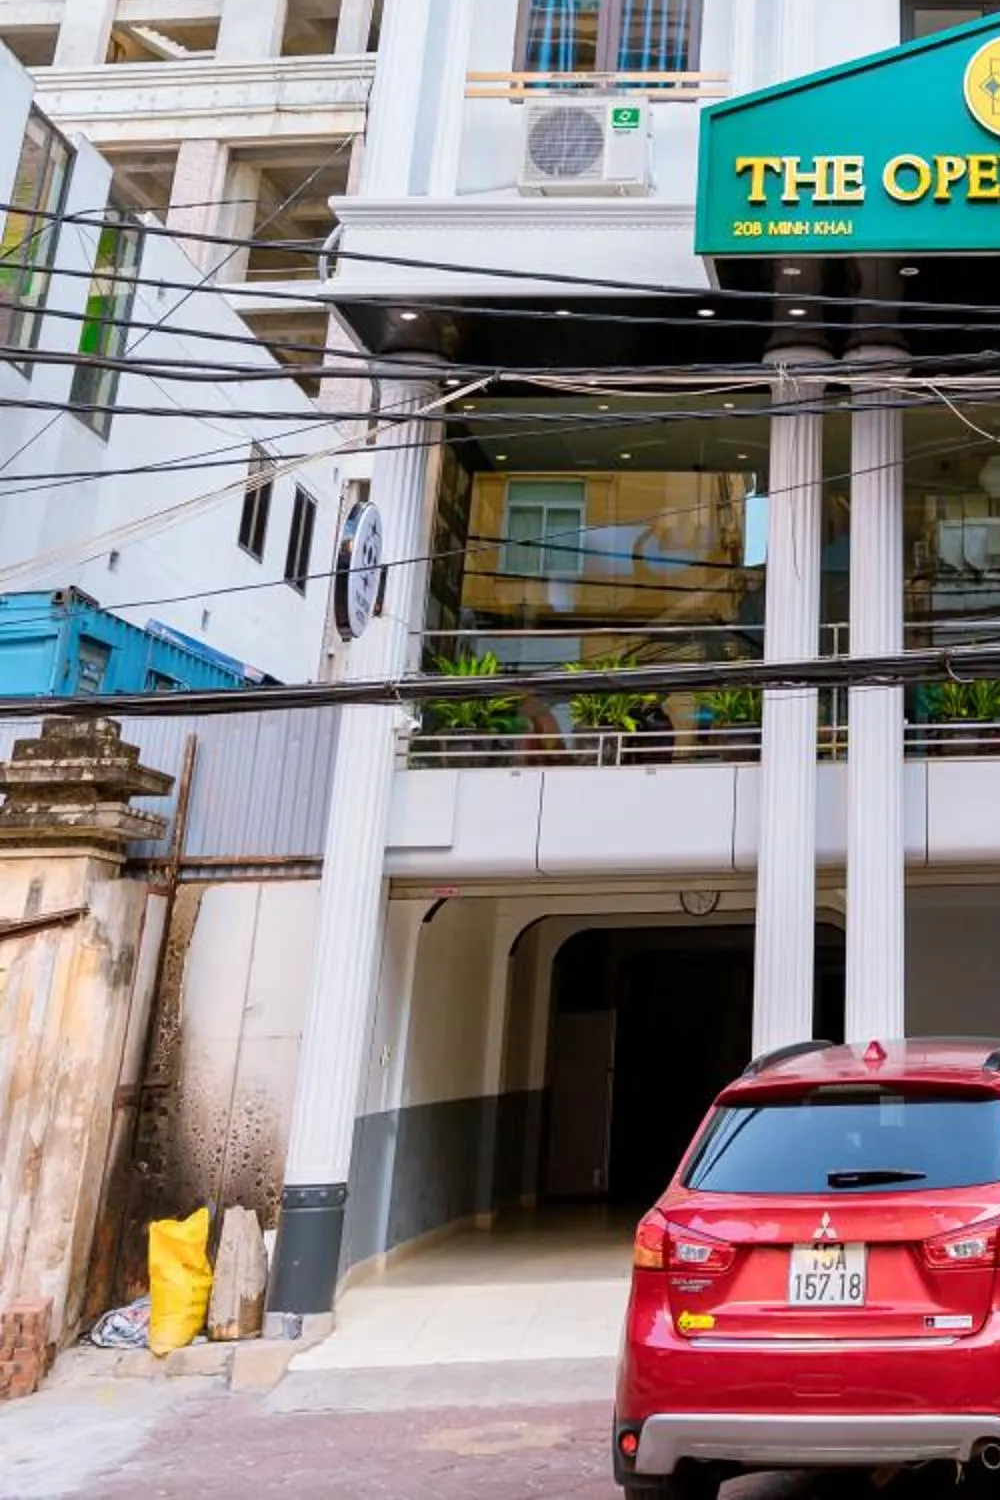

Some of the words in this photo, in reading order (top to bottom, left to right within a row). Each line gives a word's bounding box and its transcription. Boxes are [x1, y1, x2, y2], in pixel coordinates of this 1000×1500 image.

[735, 155, 865, 203] THE
[768, 220, 809, 236] MINH
[813, 219, 852, 235] KHAI
[795, 1273, 861, 1301] 157.18
